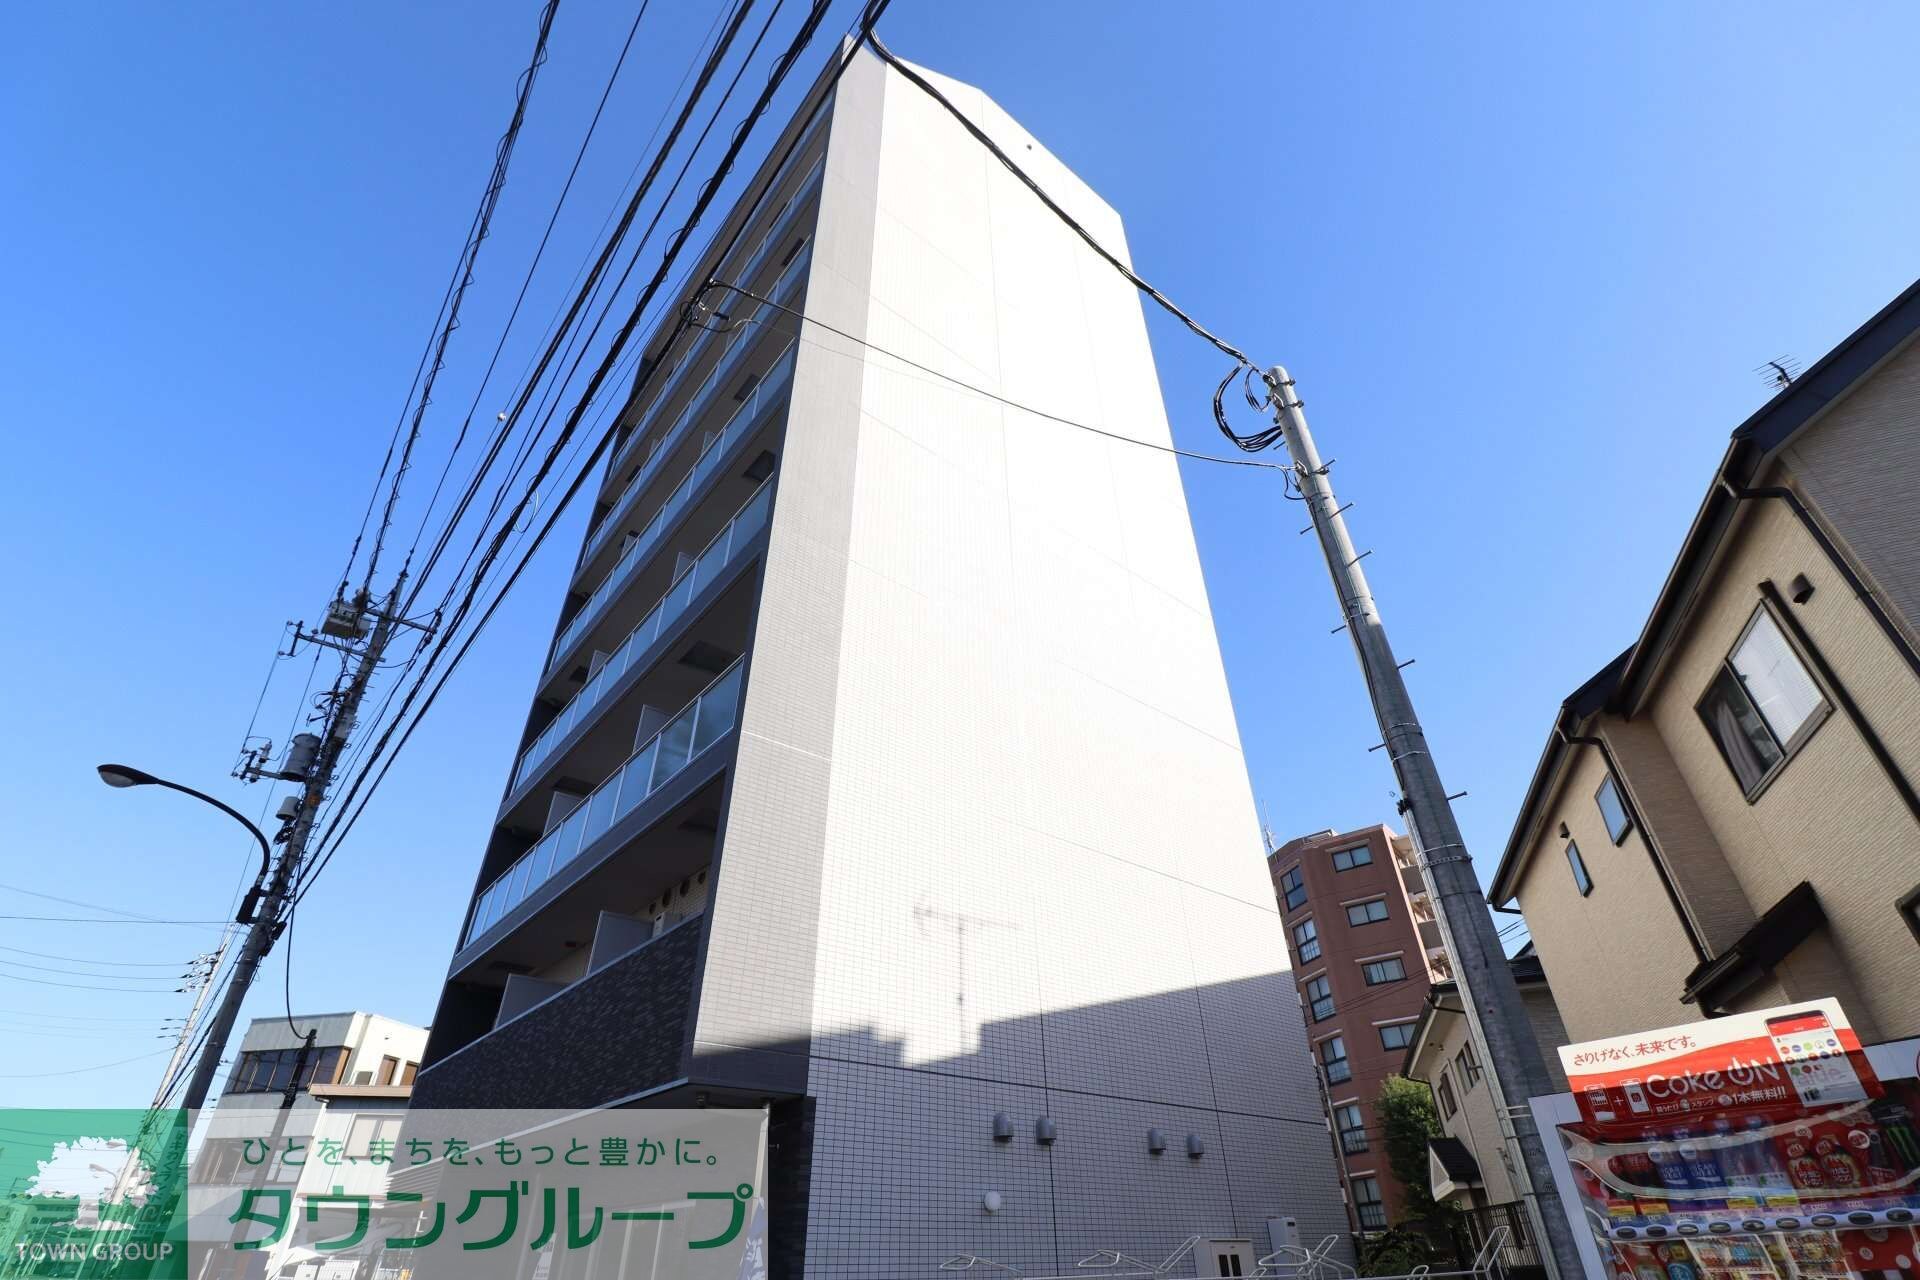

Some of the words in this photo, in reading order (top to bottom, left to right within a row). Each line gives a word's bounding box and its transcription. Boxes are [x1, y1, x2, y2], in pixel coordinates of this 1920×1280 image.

[1573, 1034, 1697, 1066] さりげなく、未来です。
[1646, 1069, 1724, 1098] Coke
[1728, 1057, 1780, 1085] ON
